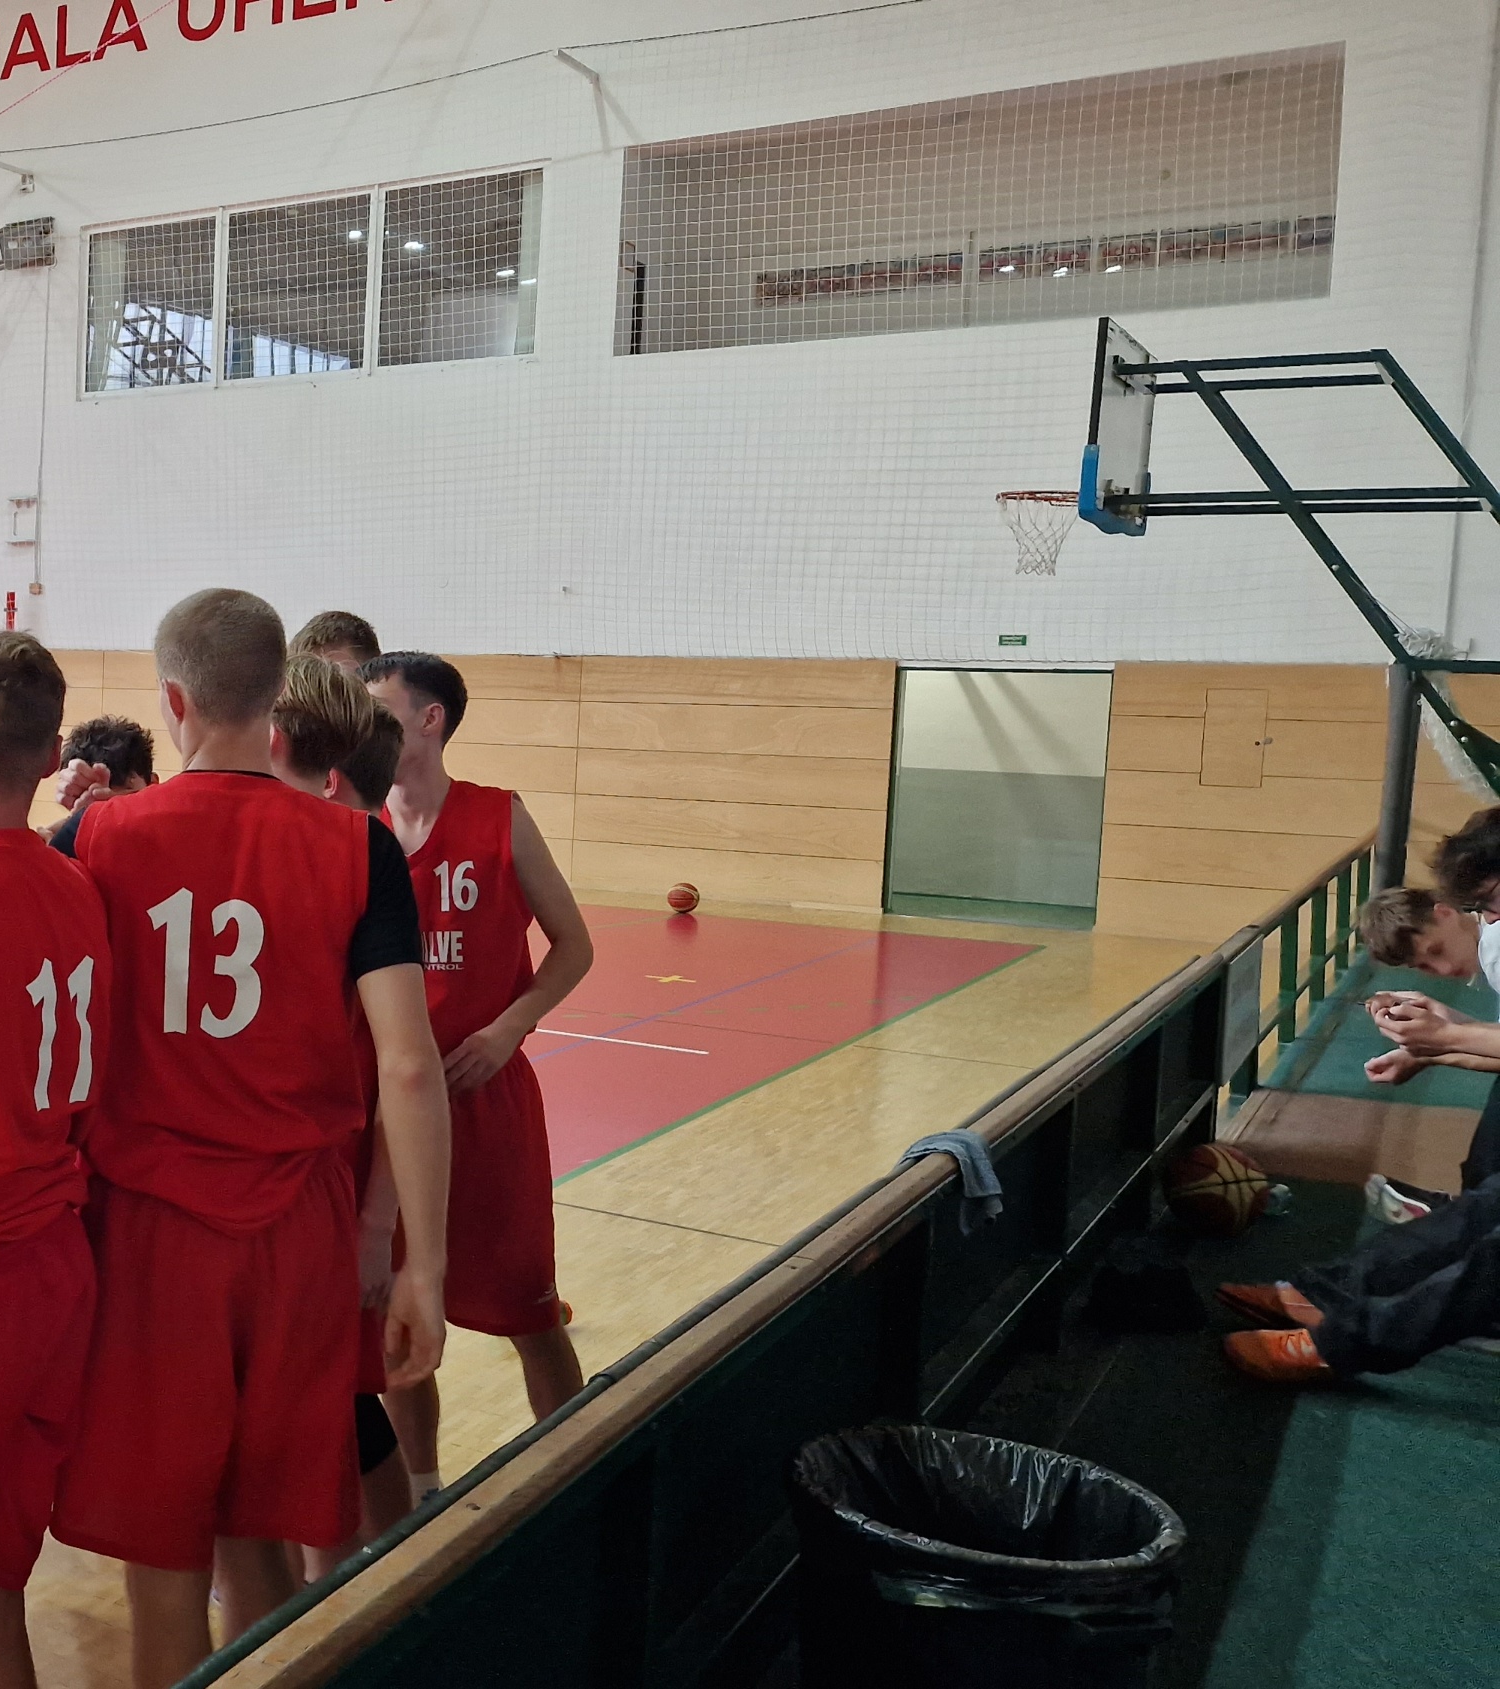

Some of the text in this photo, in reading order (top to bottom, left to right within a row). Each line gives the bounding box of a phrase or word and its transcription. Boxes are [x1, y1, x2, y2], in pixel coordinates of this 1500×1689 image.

[433, 860, 478, 912] 16
[25, 955, 94, 1111] 11
[146, 887, 264, 1039] 13
